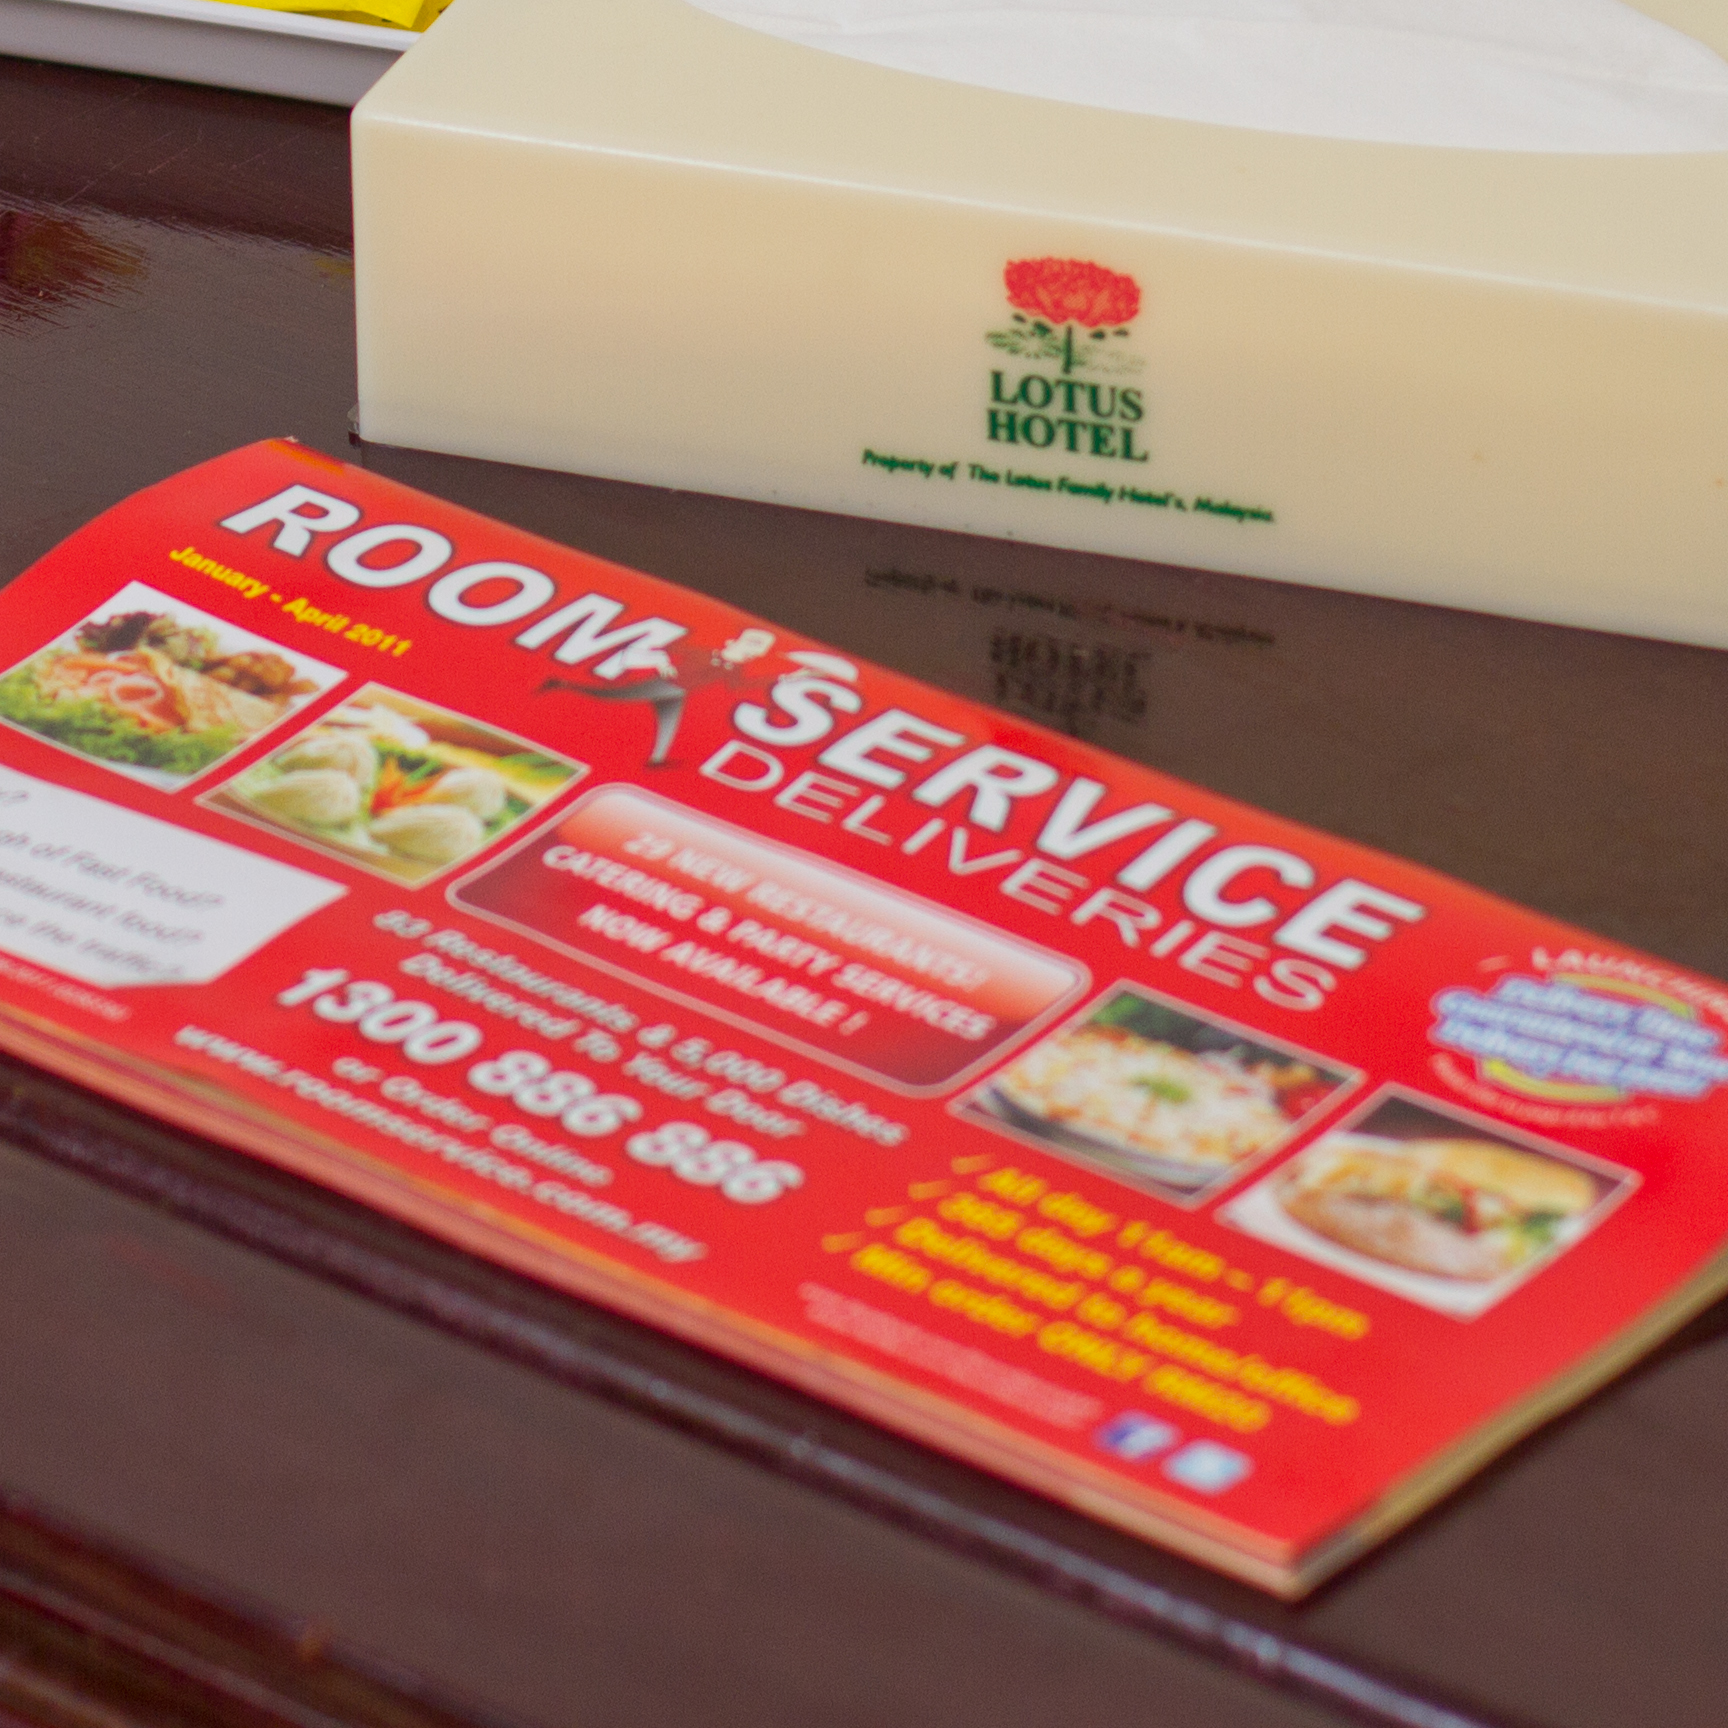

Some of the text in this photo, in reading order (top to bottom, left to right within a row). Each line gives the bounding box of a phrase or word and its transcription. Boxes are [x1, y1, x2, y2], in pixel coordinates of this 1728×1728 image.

[986, 408, 1149, 463] HOTEL
[989, 370, 1144, 423] LOTUS
[862, 448, 933, 479] Property
[938, 461, 960, 481] of
[968, 463, 1001, 484] The
[1005, 470, 1052, 492] Lotus
[1057, 476, 1114, 504] Family
[170, 544, 268, 598] January
[282, 596, 345, 638] April
[343, 618, 412, 658] 2011
[220, 484, 687, 680] ROOM
[63, 849, 132, 883] Fast
[125, 870, 226, 909] Food?
[668, 849, 752, 894] NEW
[699, 739, 1336, 1012] DELIVERIES
[733, 670, 1427, 971] SERVICE
[27, 919, 78, 948] the
[540, 843, 995, 1042] CATERING & PARTY SERVICES
[576, 902, 671, 954] NOW
[659, 940, 847, 1028] AVAILABLE
[277, 967, 805, 1205] 1300 886 886
[398, 951, 803, 1139] Delivered To Your Door
[419, 927, 639, 1034] Restaurants
[776, 1079, 907, 1147] Dishes
[173, 1023, 704, 1264] www.roomservice.com.my
[330, 1055, 613, 1187] or Order Online
[979, 1166, 1047, 1206] All
[1036, 1191, 1114, 1238] day
[1015, 1226, 1112, 1280] days
[894, 1216, 1085, 1311] Delivered
